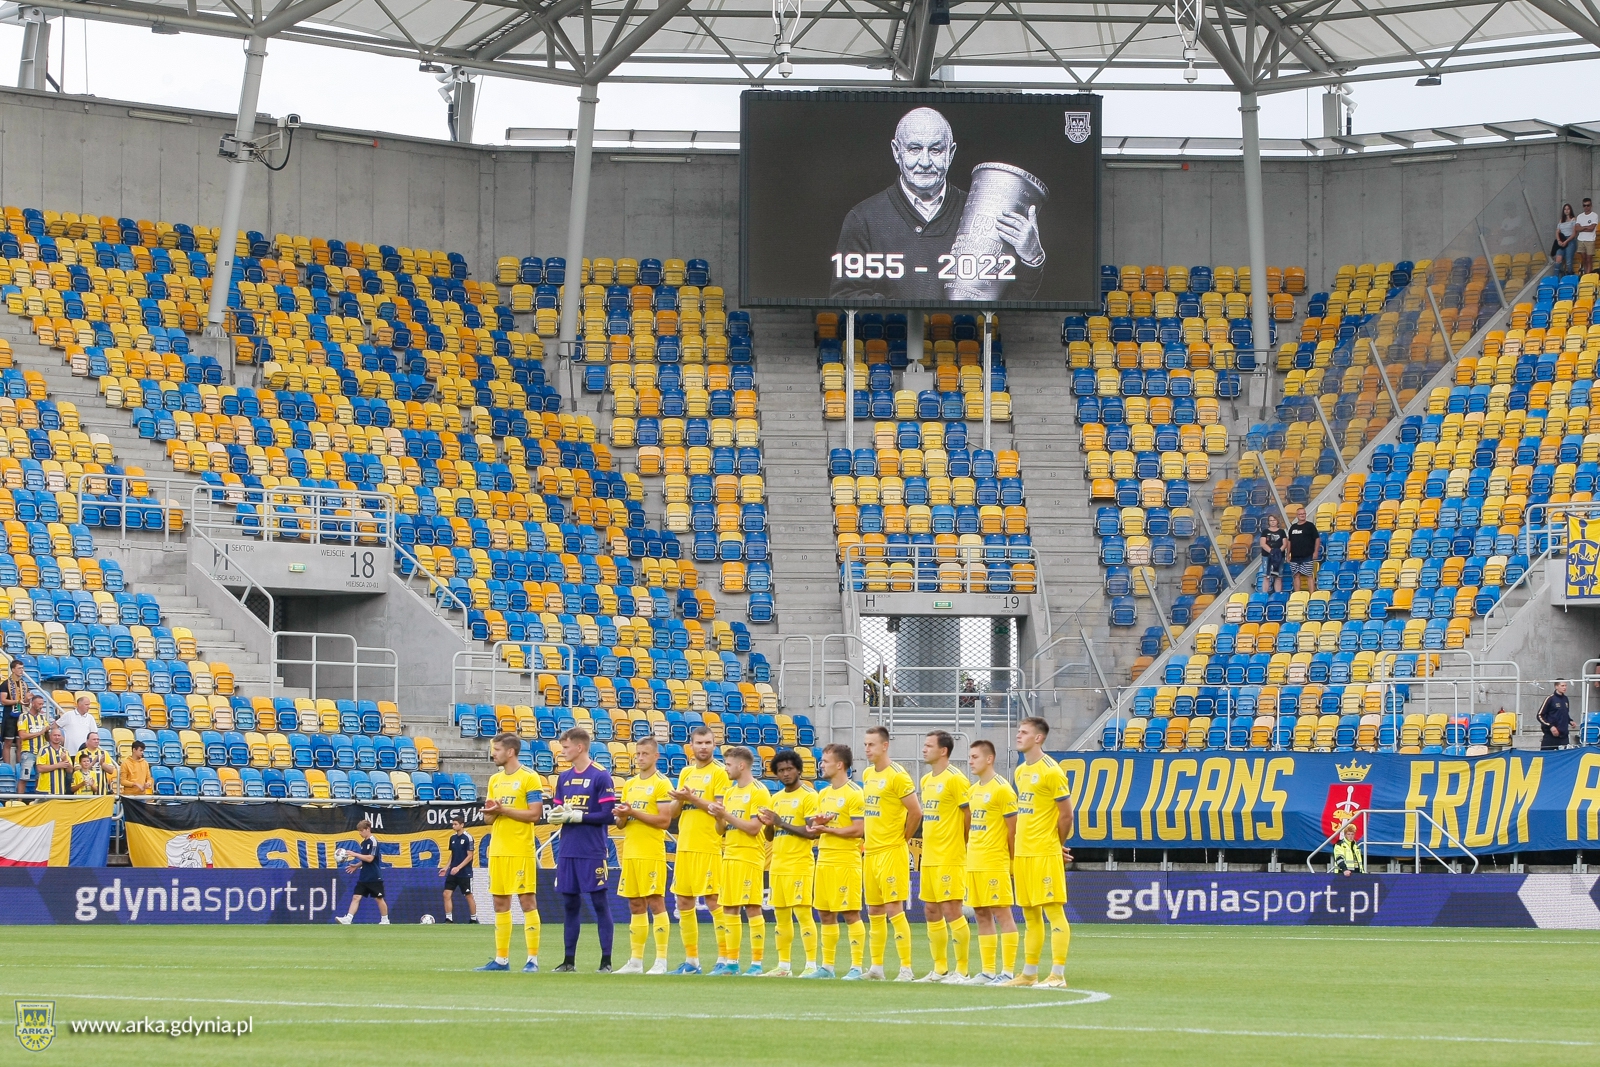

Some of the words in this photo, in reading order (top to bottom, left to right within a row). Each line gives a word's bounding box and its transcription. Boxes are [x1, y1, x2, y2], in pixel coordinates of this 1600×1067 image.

[831, 253, 905, 279] 1955
[938, 254, 1016, 280] 2022
[231, 544, 255, 552] SEKTOR
[321, 548, 345, 557] WEJŚCIE
[350, 551, 375, 578] 18
[865, 594, 875, 607] H
[1003, 596, 1020, 609] 19
[1402, 756, 1544, 849] FROM
[364, 811, 384, 829] NA
[74, 878, 337, 921] gdyniasport.pl
[1106, 881, 1379, 922] gdyniasport.pl
